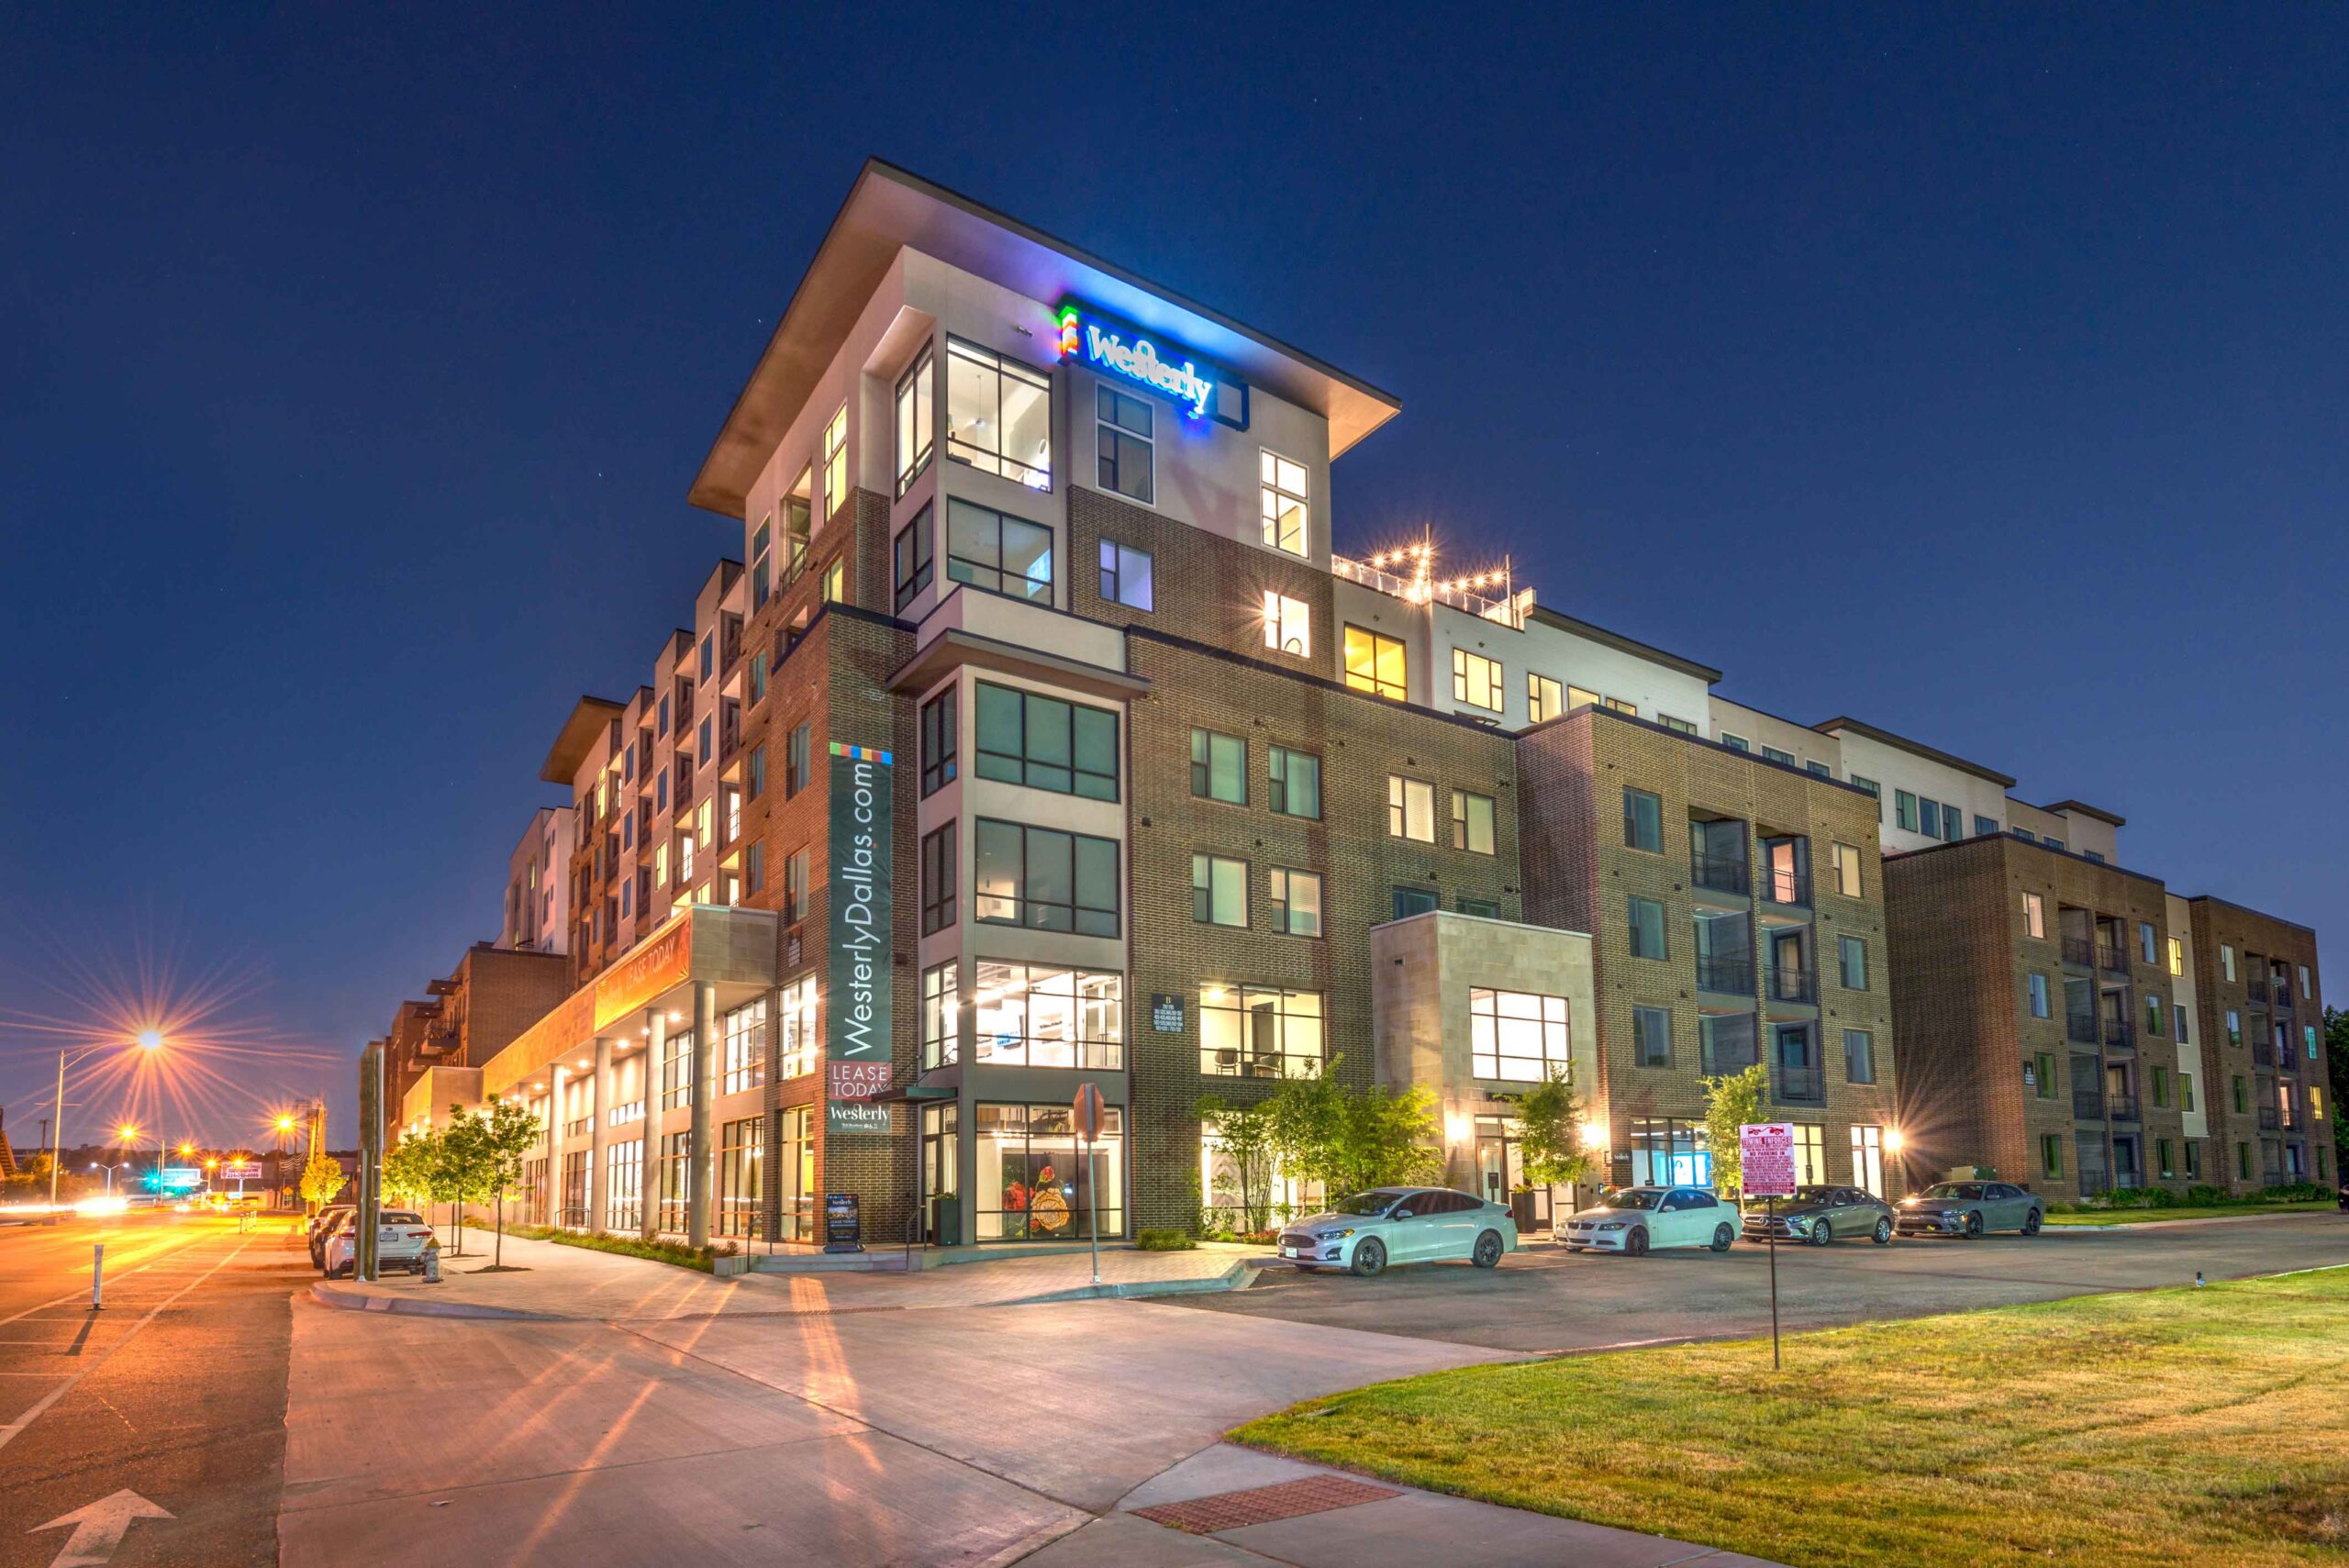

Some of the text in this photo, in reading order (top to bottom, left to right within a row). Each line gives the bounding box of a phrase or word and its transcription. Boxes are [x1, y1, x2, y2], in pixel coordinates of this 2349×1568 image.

[1086, 325, 1212, 418] Westerly
[842, 762, 881, 1057] WesterlyDallas.com
[626, 957, 646, 991] LEASE
[649, 936, 675, 974] TODAY
[833, 1065, 886, 1081] LEASE
[833, 1082, 887, 1096] TODAY
[830, 1104, 890, 1126] Westerly
